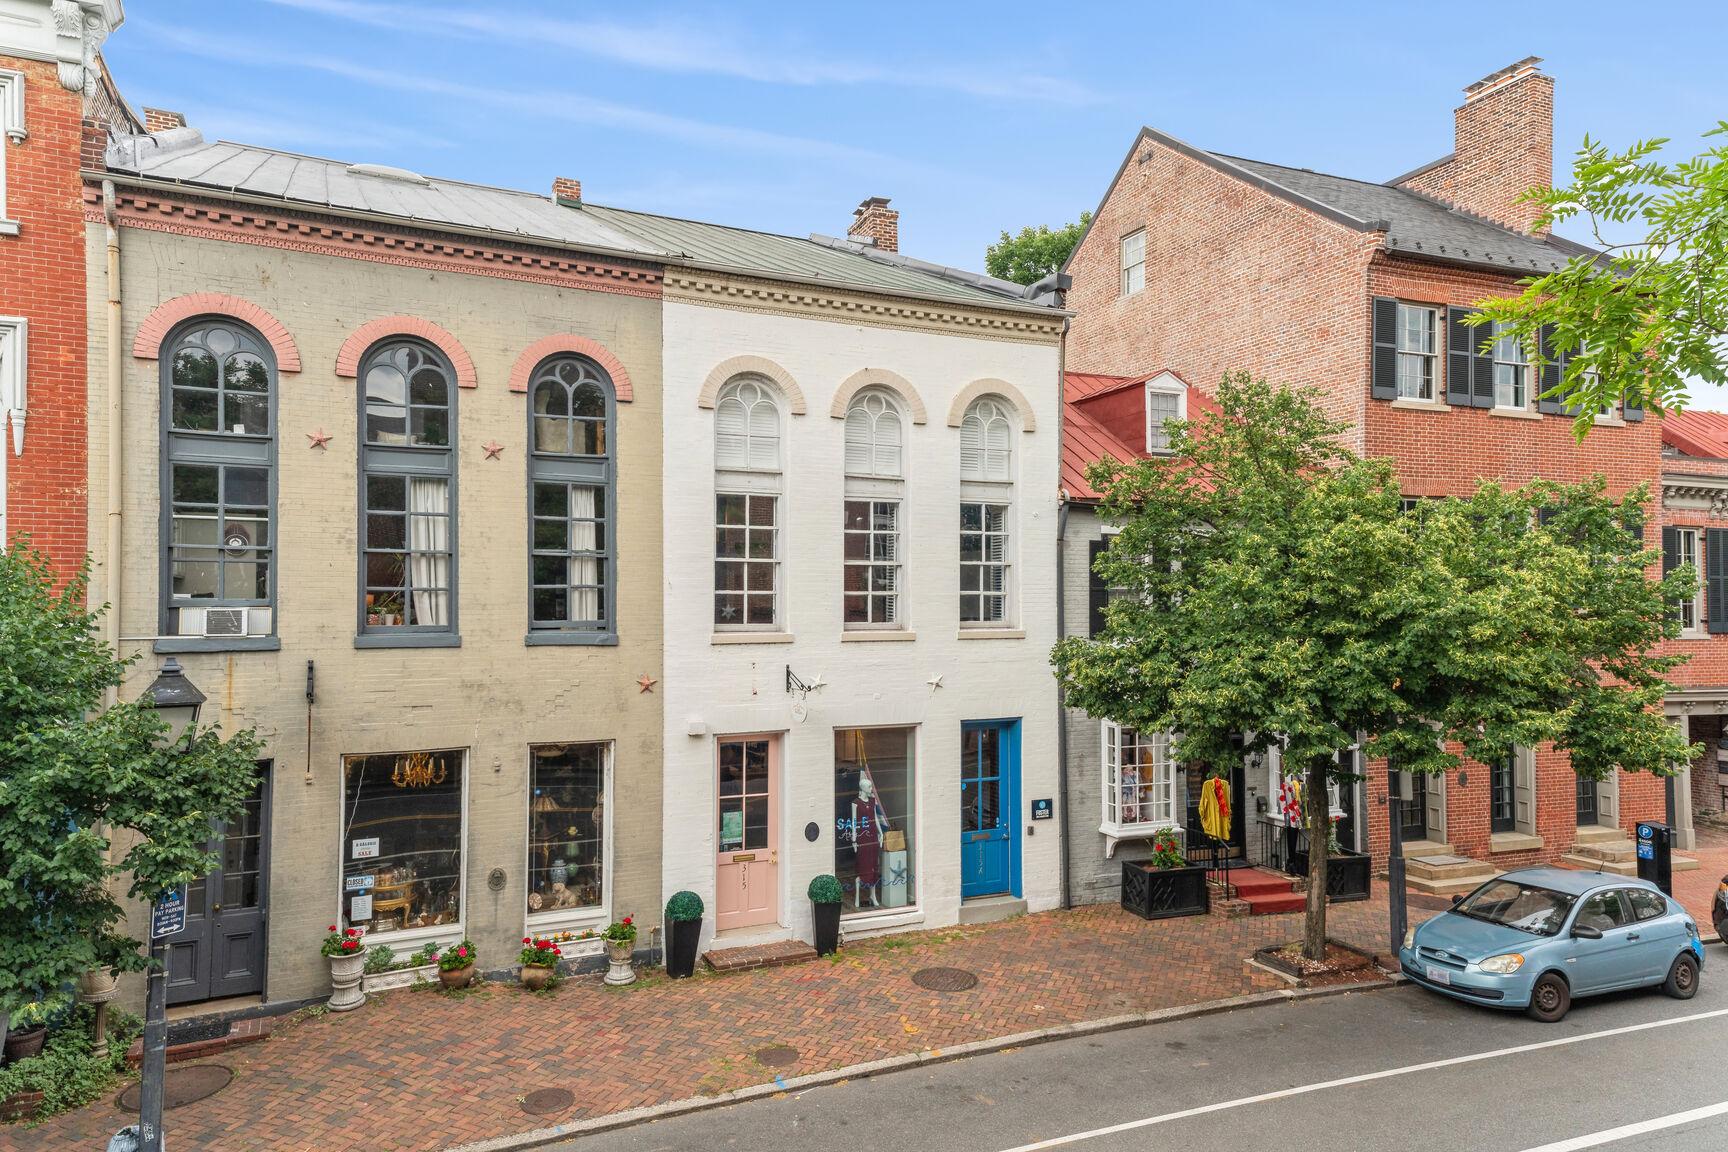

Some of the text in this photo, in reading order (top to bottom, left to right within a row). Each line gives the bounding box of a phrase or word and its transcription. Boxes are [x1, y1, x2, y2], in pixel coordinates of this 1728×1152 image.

[836, 816, 870, 830] SALE
[1642, 828, 1649, 836] P
[347, 878, 363, 886] CLOSED
[165, 900, 180, 908] HOUR
[165, 905, 184, 914] PARKING
